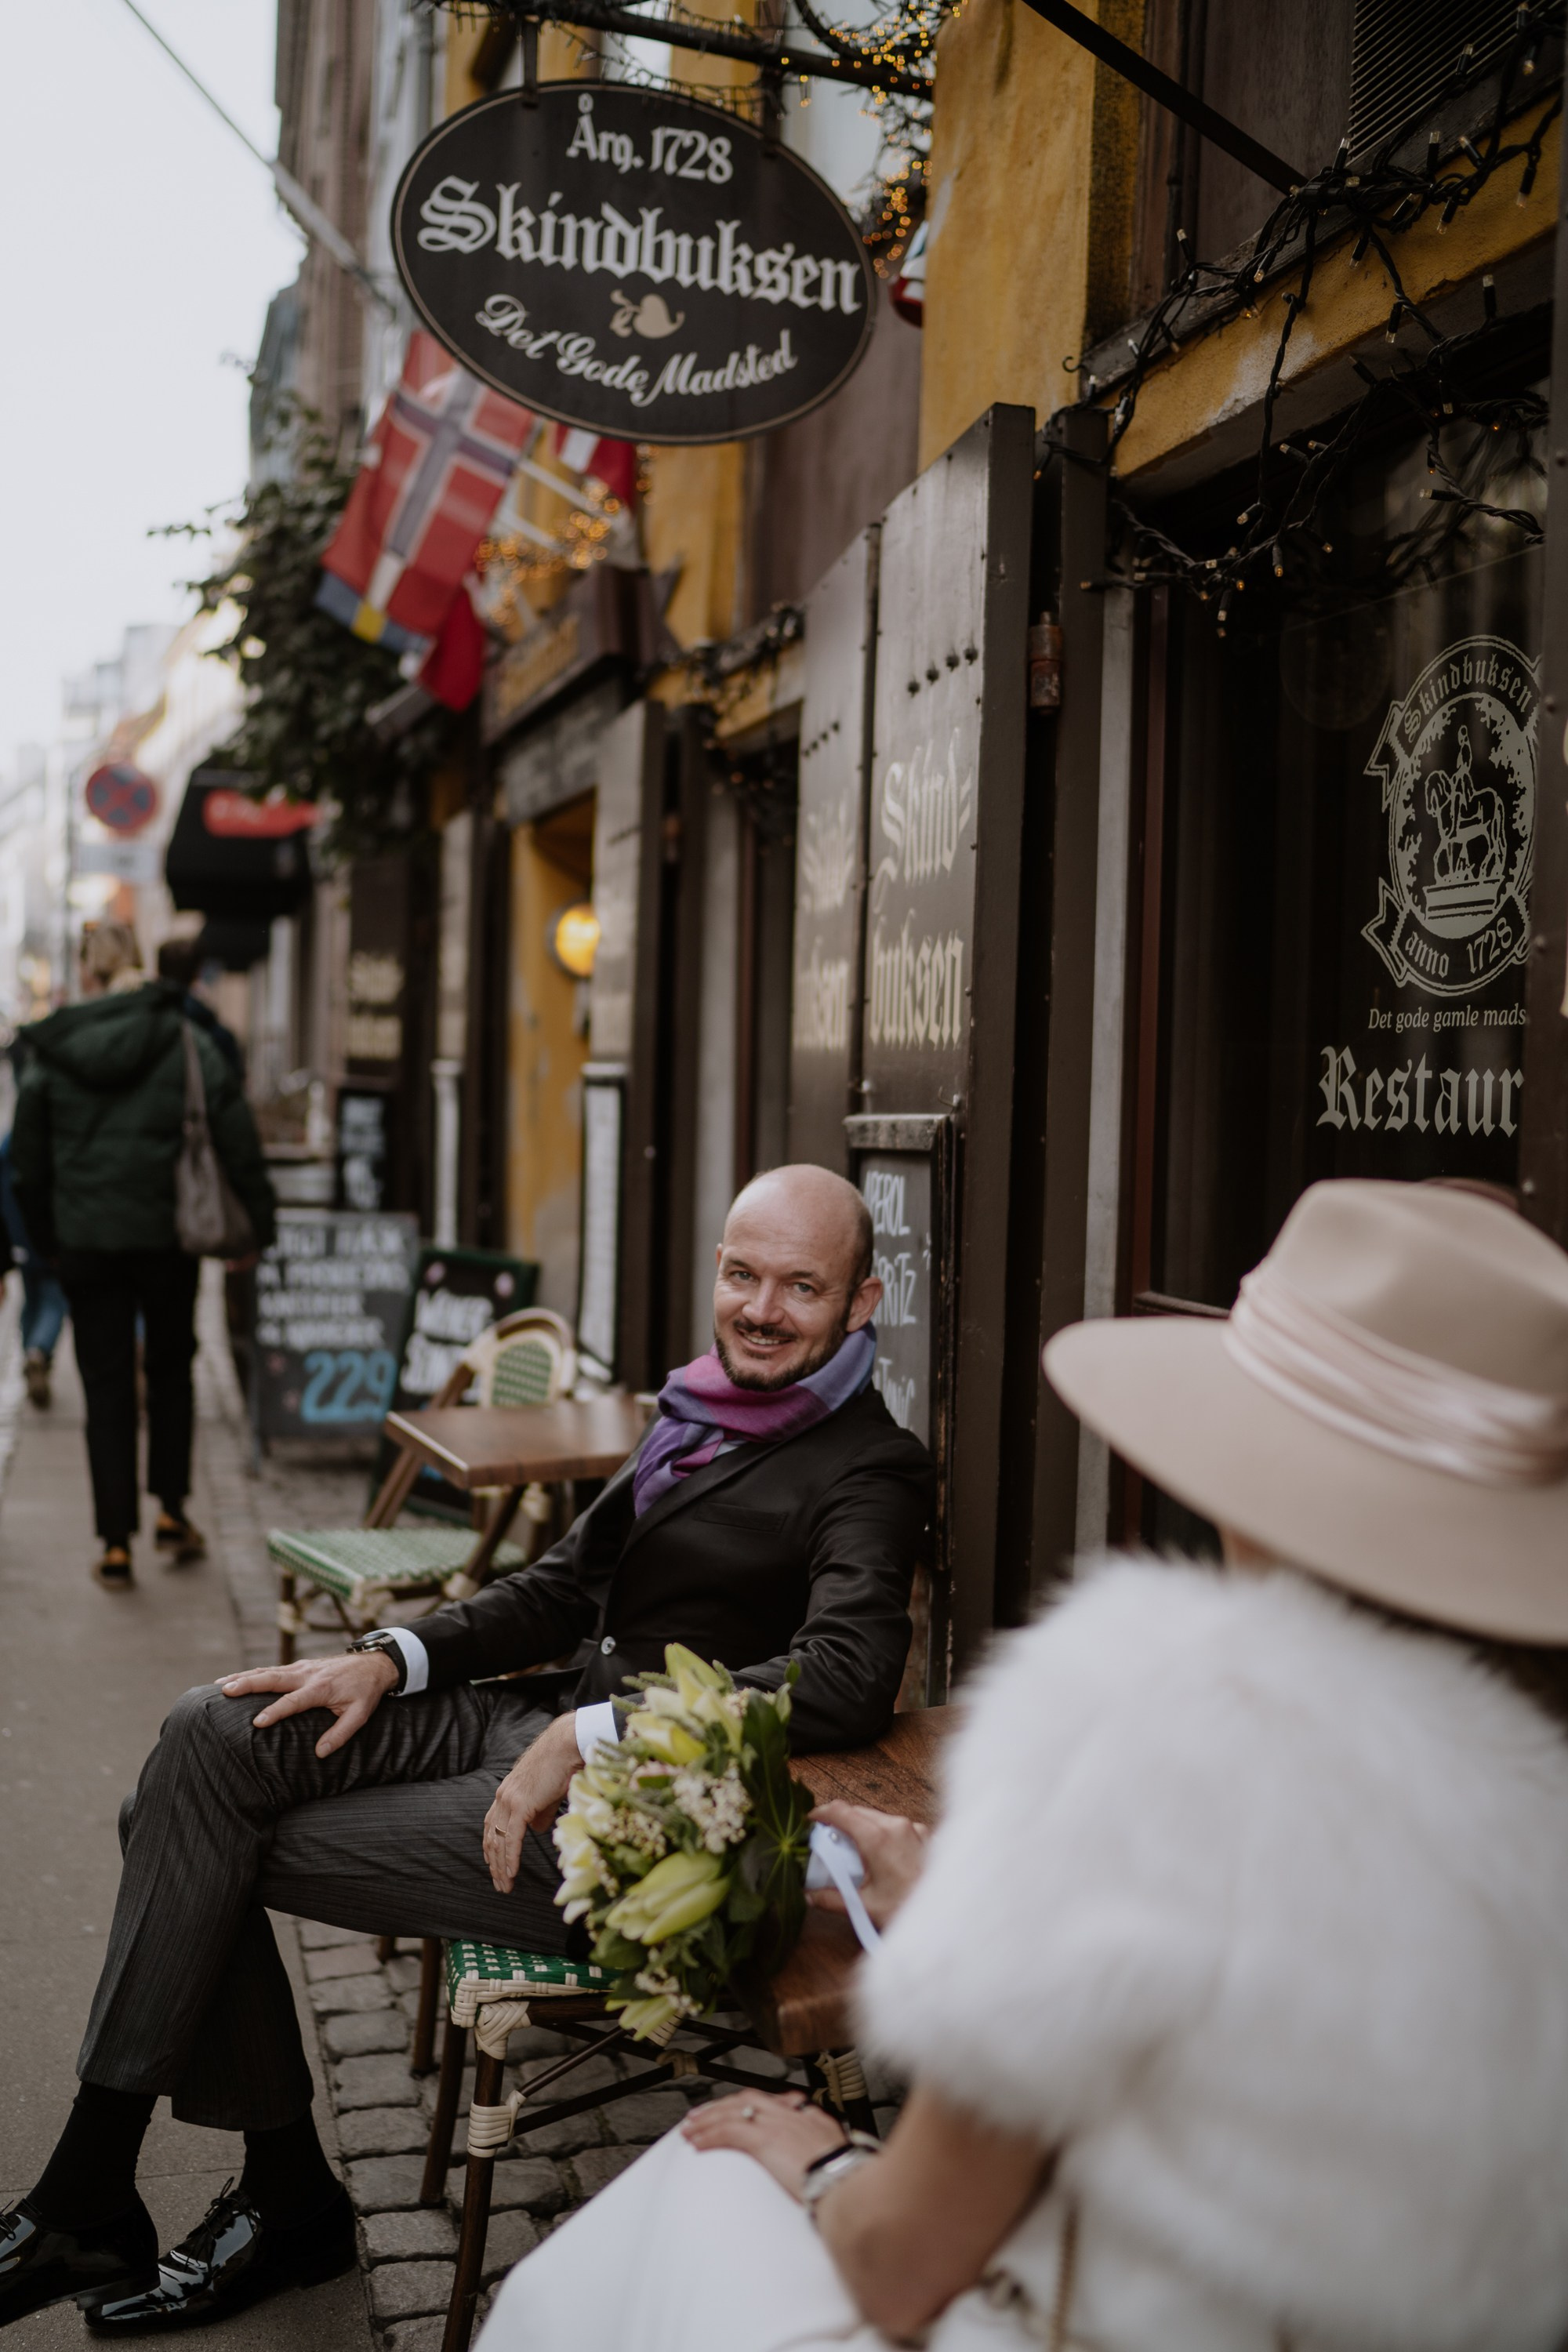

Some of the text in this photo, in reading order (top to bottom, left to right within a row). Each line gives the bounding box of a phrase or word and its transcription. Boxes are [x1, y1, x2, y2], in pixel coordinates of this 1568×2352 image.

[649, 125, 734, 184] 1728
[417, 174, 862, 314] Skindbuksen
[475, 293, 799, 408] Det Gode Madsted
[1404, 652, 1533, 743] Skindbuksen
[869, 906, 964, 1052] buksen
[1405, 916, 1513, 978] anno 1728
[1368, 1008, 1393, 1029] Det
[1396, 1007, 1429, 1034] gode
[1433, 1004, 1479, 1033] gamle
[1316, 1045, 1525, 1138] Restaur
[300, 1348, 397, 1425] 229
